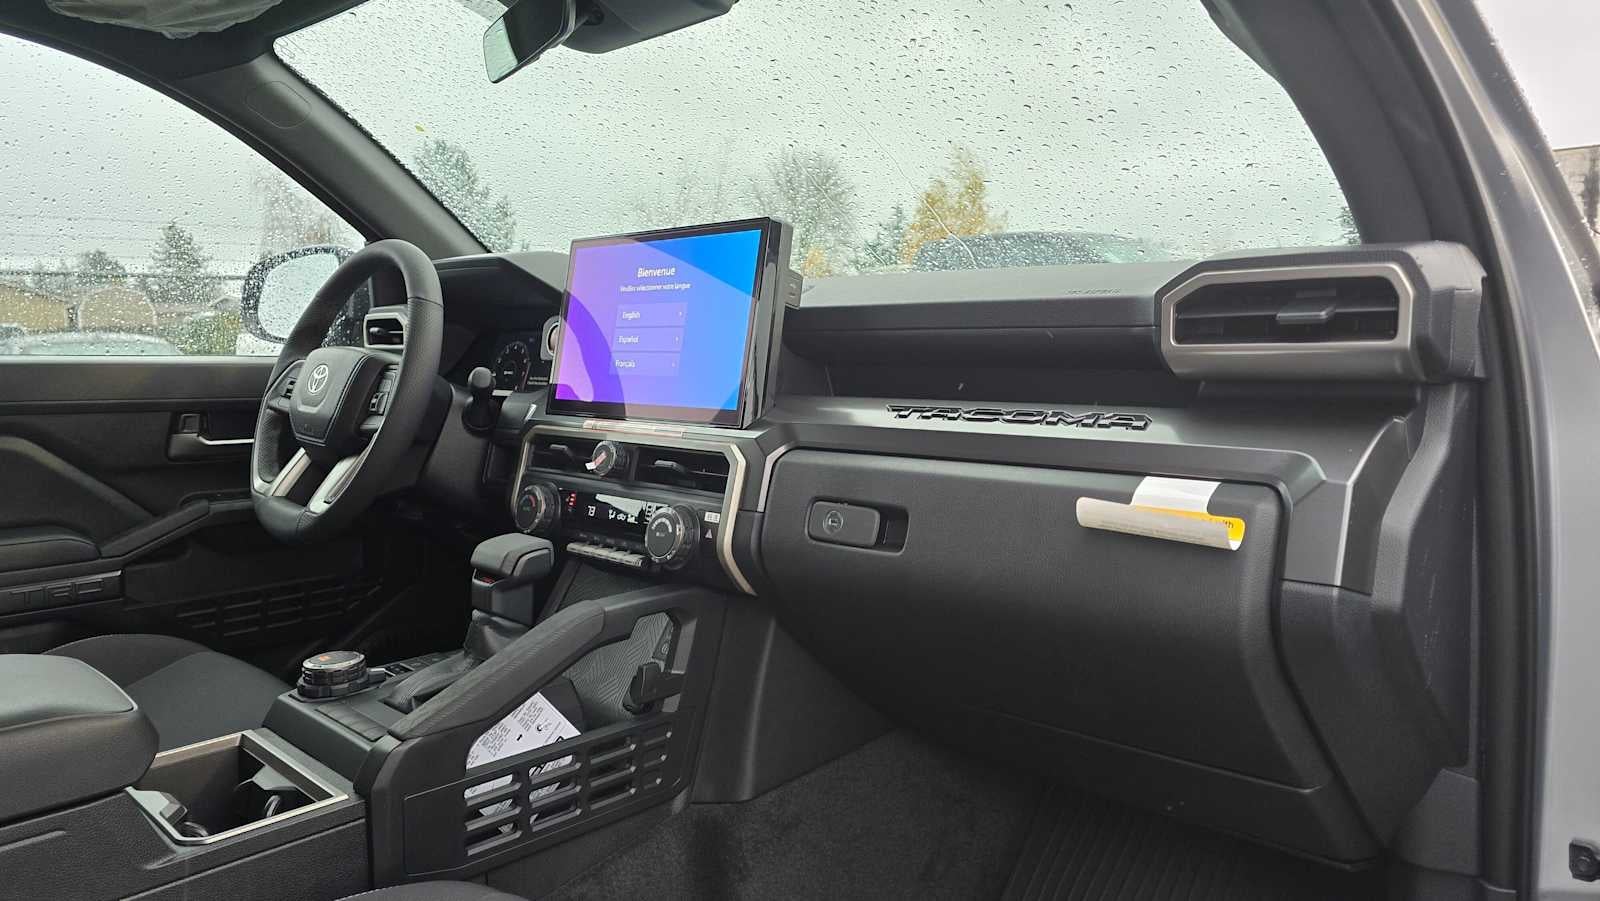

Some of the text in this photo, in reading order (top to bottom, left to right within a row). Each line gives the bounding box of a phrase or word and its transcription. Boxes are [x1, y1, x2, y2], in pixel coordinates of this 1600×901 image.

[638, 267, 676, 278] Bienvenue
[675, 282, 691, 290] langue
[622, 311, 641, 320] English
[618, 336, 639, 344] Español
[886, 404, 1153, 431] TACOMA
